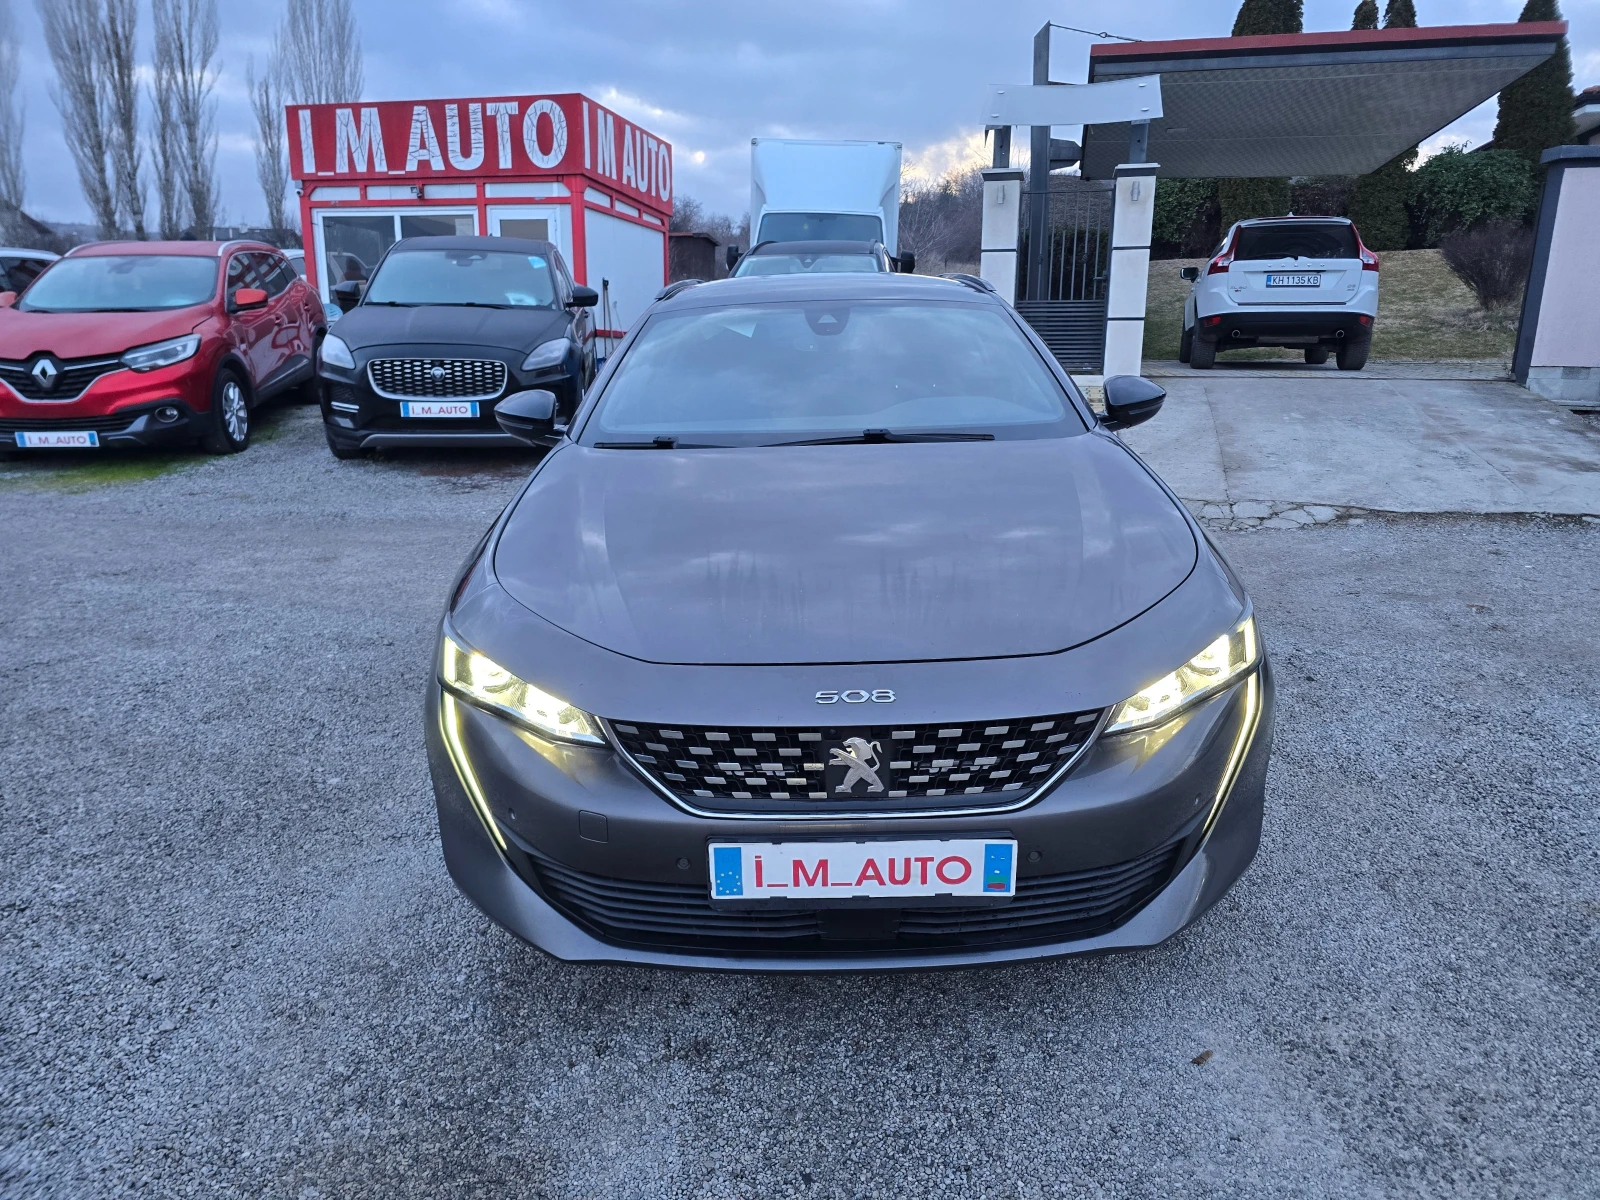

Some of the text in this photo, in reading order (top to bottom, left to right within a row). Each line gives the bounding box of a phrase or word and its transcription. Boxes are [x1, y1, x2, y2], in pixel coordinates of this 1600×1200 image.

[582, 100, 670, 202] I M AUTO
[1286, 276, 1306, 285] 1135
[815, 689, 897, 704] 508
